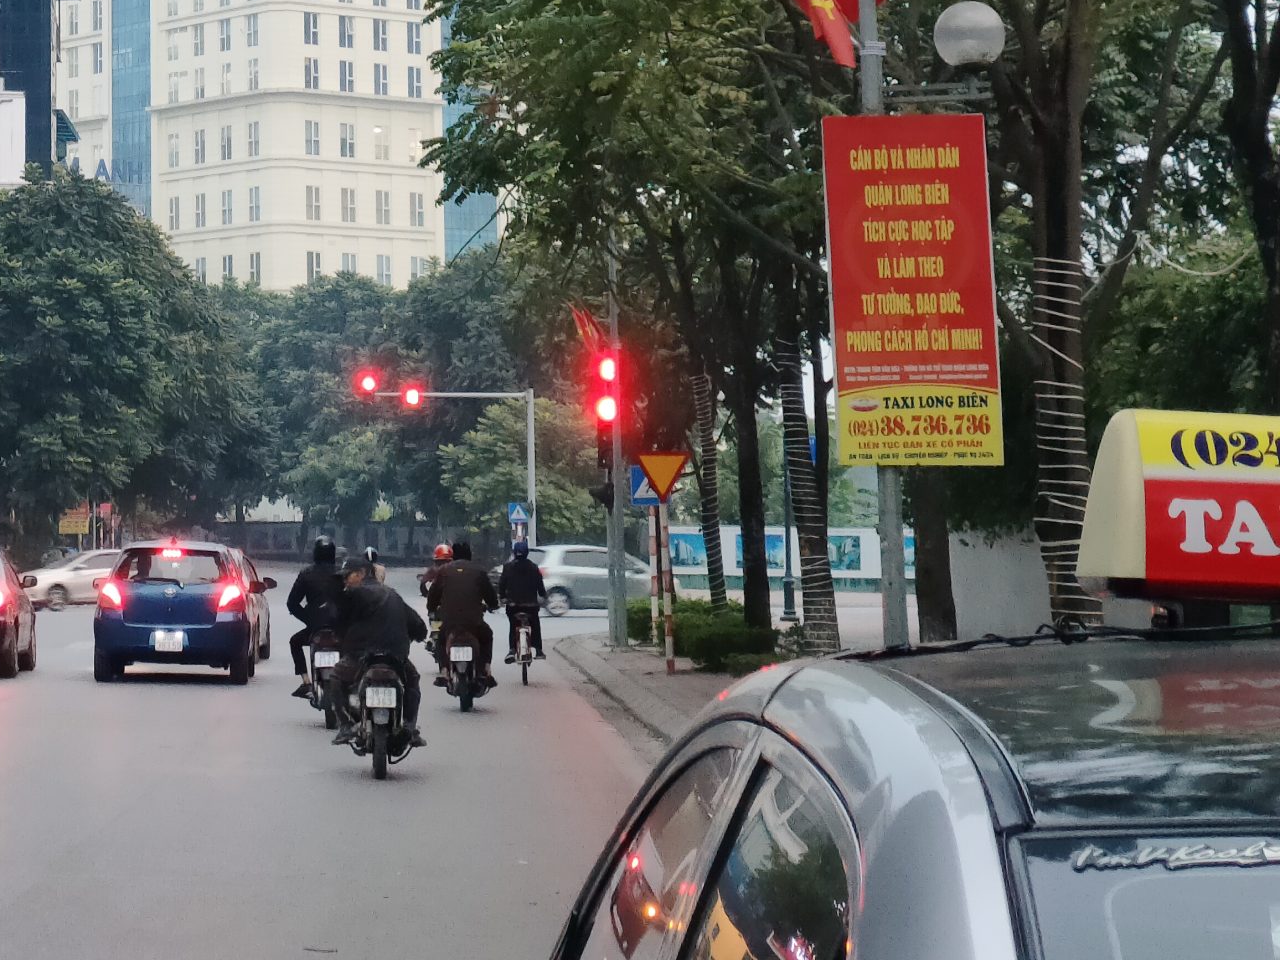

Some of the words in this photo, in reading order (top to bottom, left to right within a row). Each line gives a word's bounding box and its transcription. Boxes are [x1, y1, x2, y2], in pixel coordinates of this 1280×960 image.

[850, 145, 871, 170] CÁN
[874, 145, 888, 174] BỘ
[890, 144, 904, 169] VÀ
[907, 143, 935, 169] NHÂN
[938, 143, 960, 169] DÂN
[864, 181, 893, 211] QUẬN
[895, 184, 922, 205] LONG
[925, 179, 949, 205] BIÊN
[863, 217, 886, 242] TÍCH
[888, 218, 909, 246] CỰC
[911, 220, 932, 246] HỌC
[935, 216, 955, 245] TẬP
[877, 253, 891, 279] VÀ
[894, 253, 916, 279] LÀM
[918, 256, 944, 278] THEO
[862, 292, 875, 315] TƯ
[917, 292, 937, 318] ĐẠO
[846, 331, 882, 352] PHONG
[884, 326, 912, 351] CÁCH
[915, 323, 929, 351] HỒ
[931, 324, 949, 351] CHÍ
[951, 328, 983, 350] MINH!
[883, 396, 915, 409] TAXI
[919, 395, 954, 409] LONG
[958, 392, 989, 408] BIÊN
[926, 440, 938, 449] XE
